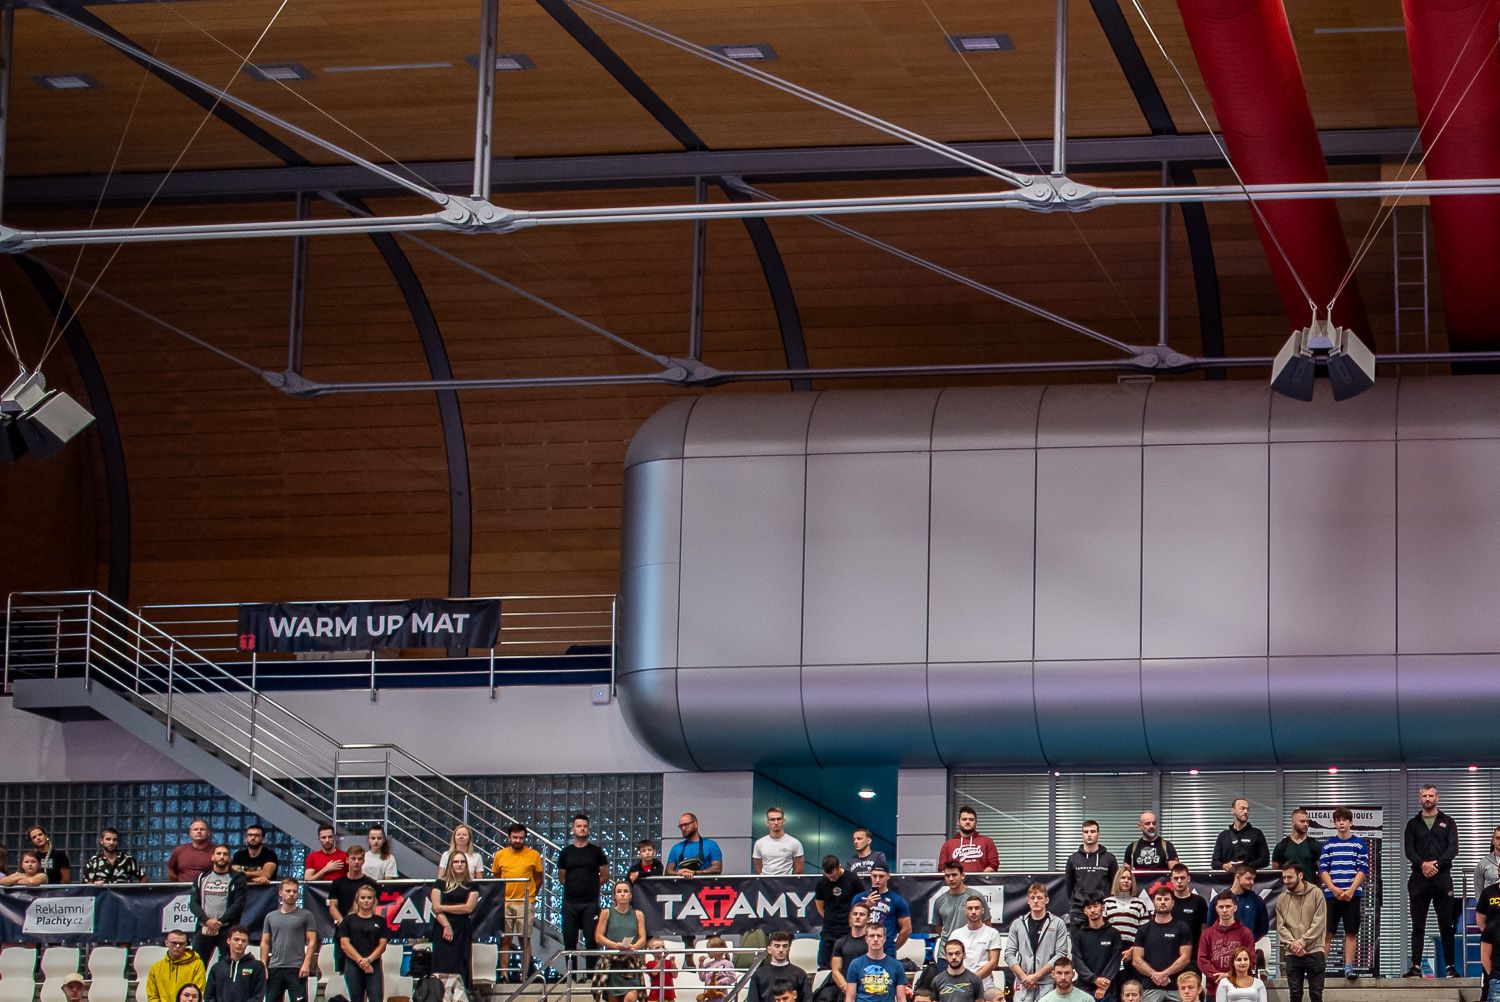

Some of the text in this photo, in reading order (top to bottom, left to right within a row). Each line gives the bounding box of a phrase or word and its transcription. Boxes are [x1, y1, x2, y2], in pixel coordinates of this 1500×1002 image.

[268, 612, 470, 637] WARM UP MAT
[35, 904, 84, 914] Reklamni
[657, 890, 817, 921] TATAMY
[36, 916, 83, 926] Plachty.cz
